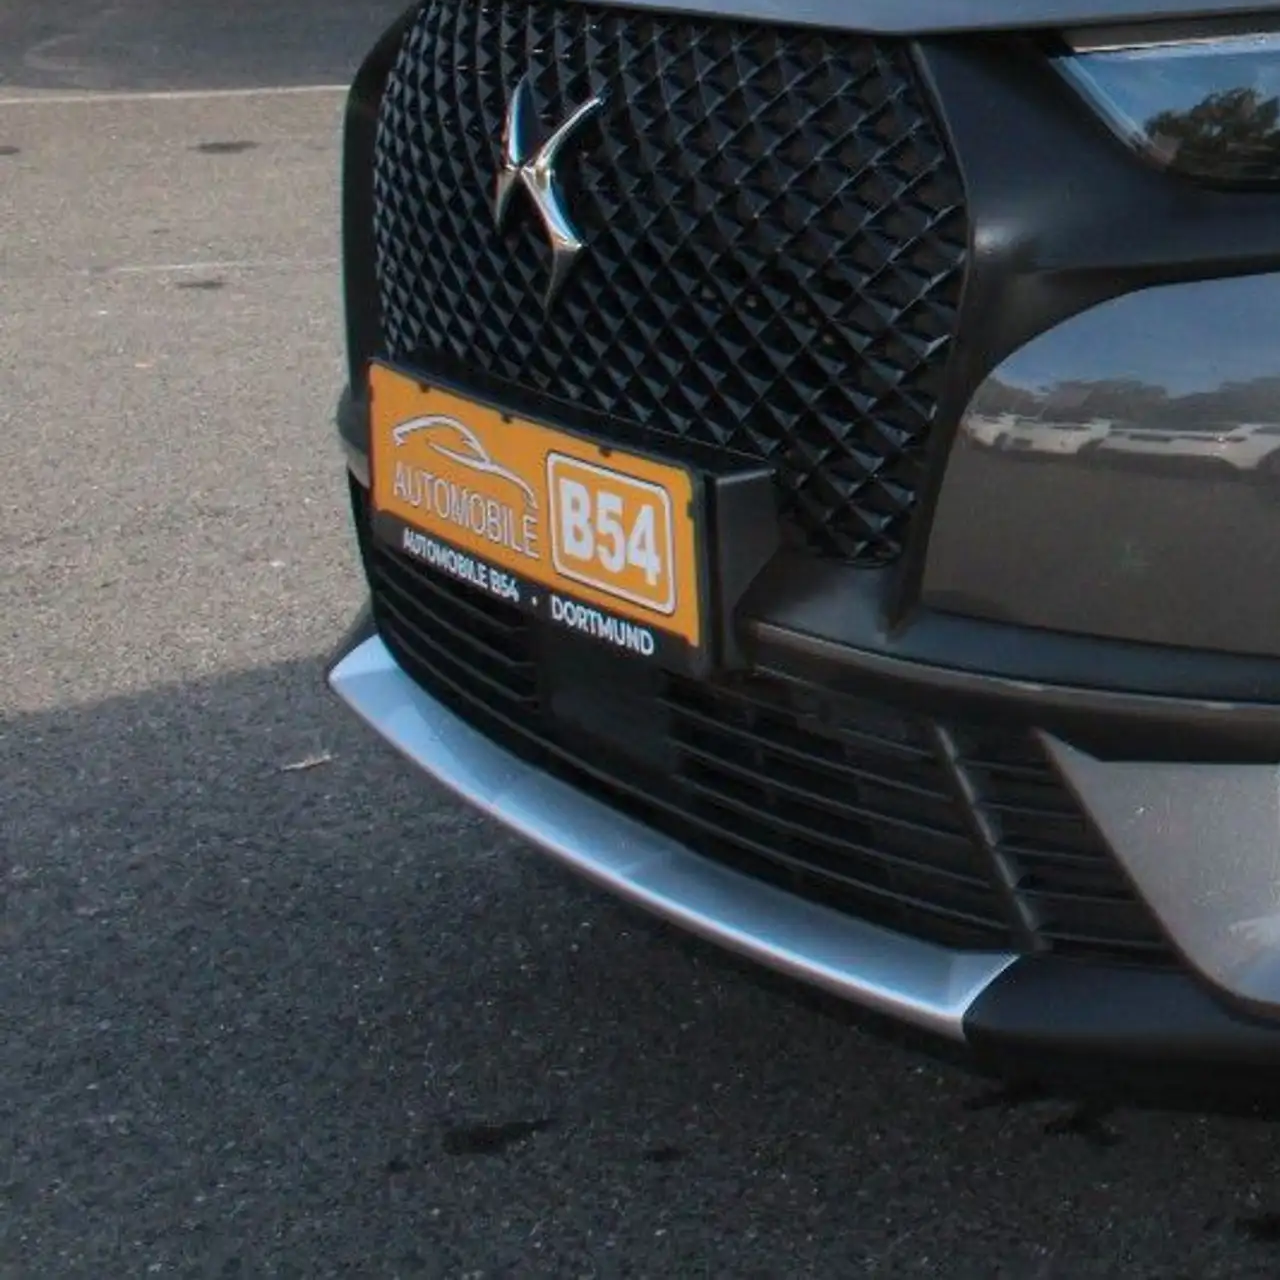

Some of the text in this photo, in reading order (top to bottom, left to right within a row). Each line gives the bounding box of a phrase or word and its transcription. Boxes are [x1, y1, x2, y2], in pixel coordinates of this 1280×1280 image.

[392, 460, 662, 587] AUTOMOBILE B54
[403, 526, 655, 656] AUTOMOBILE B54 DORTMUND
